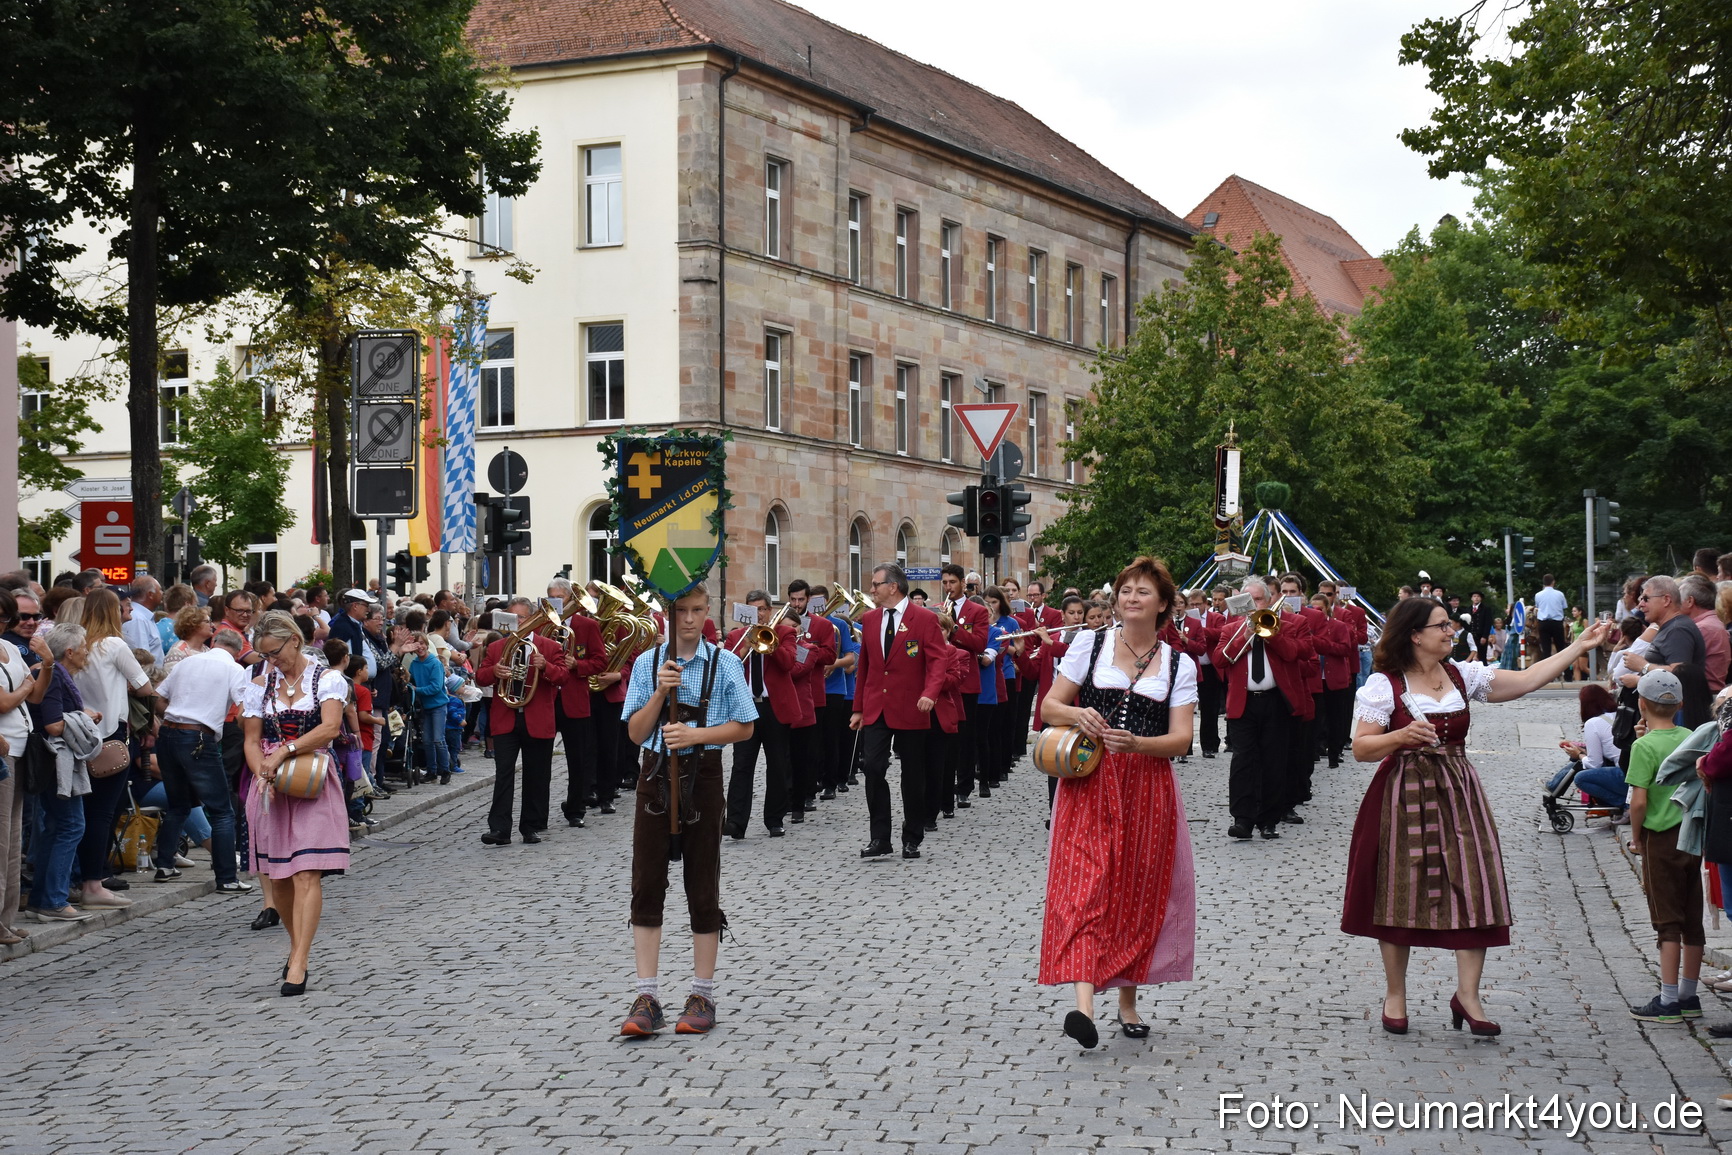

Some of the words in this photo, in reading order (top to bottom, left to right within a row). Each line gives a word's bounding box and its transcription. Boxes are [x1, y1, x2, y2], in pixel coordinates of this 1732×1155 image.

[376, 352, 397, 369] 30
[373, 382, 400, 392] ZONE
[372, 448, 399, 459] ZONE
[664, 458, 702, 467] Kapelle
[633, 499, 677, 530] Neumarkt
